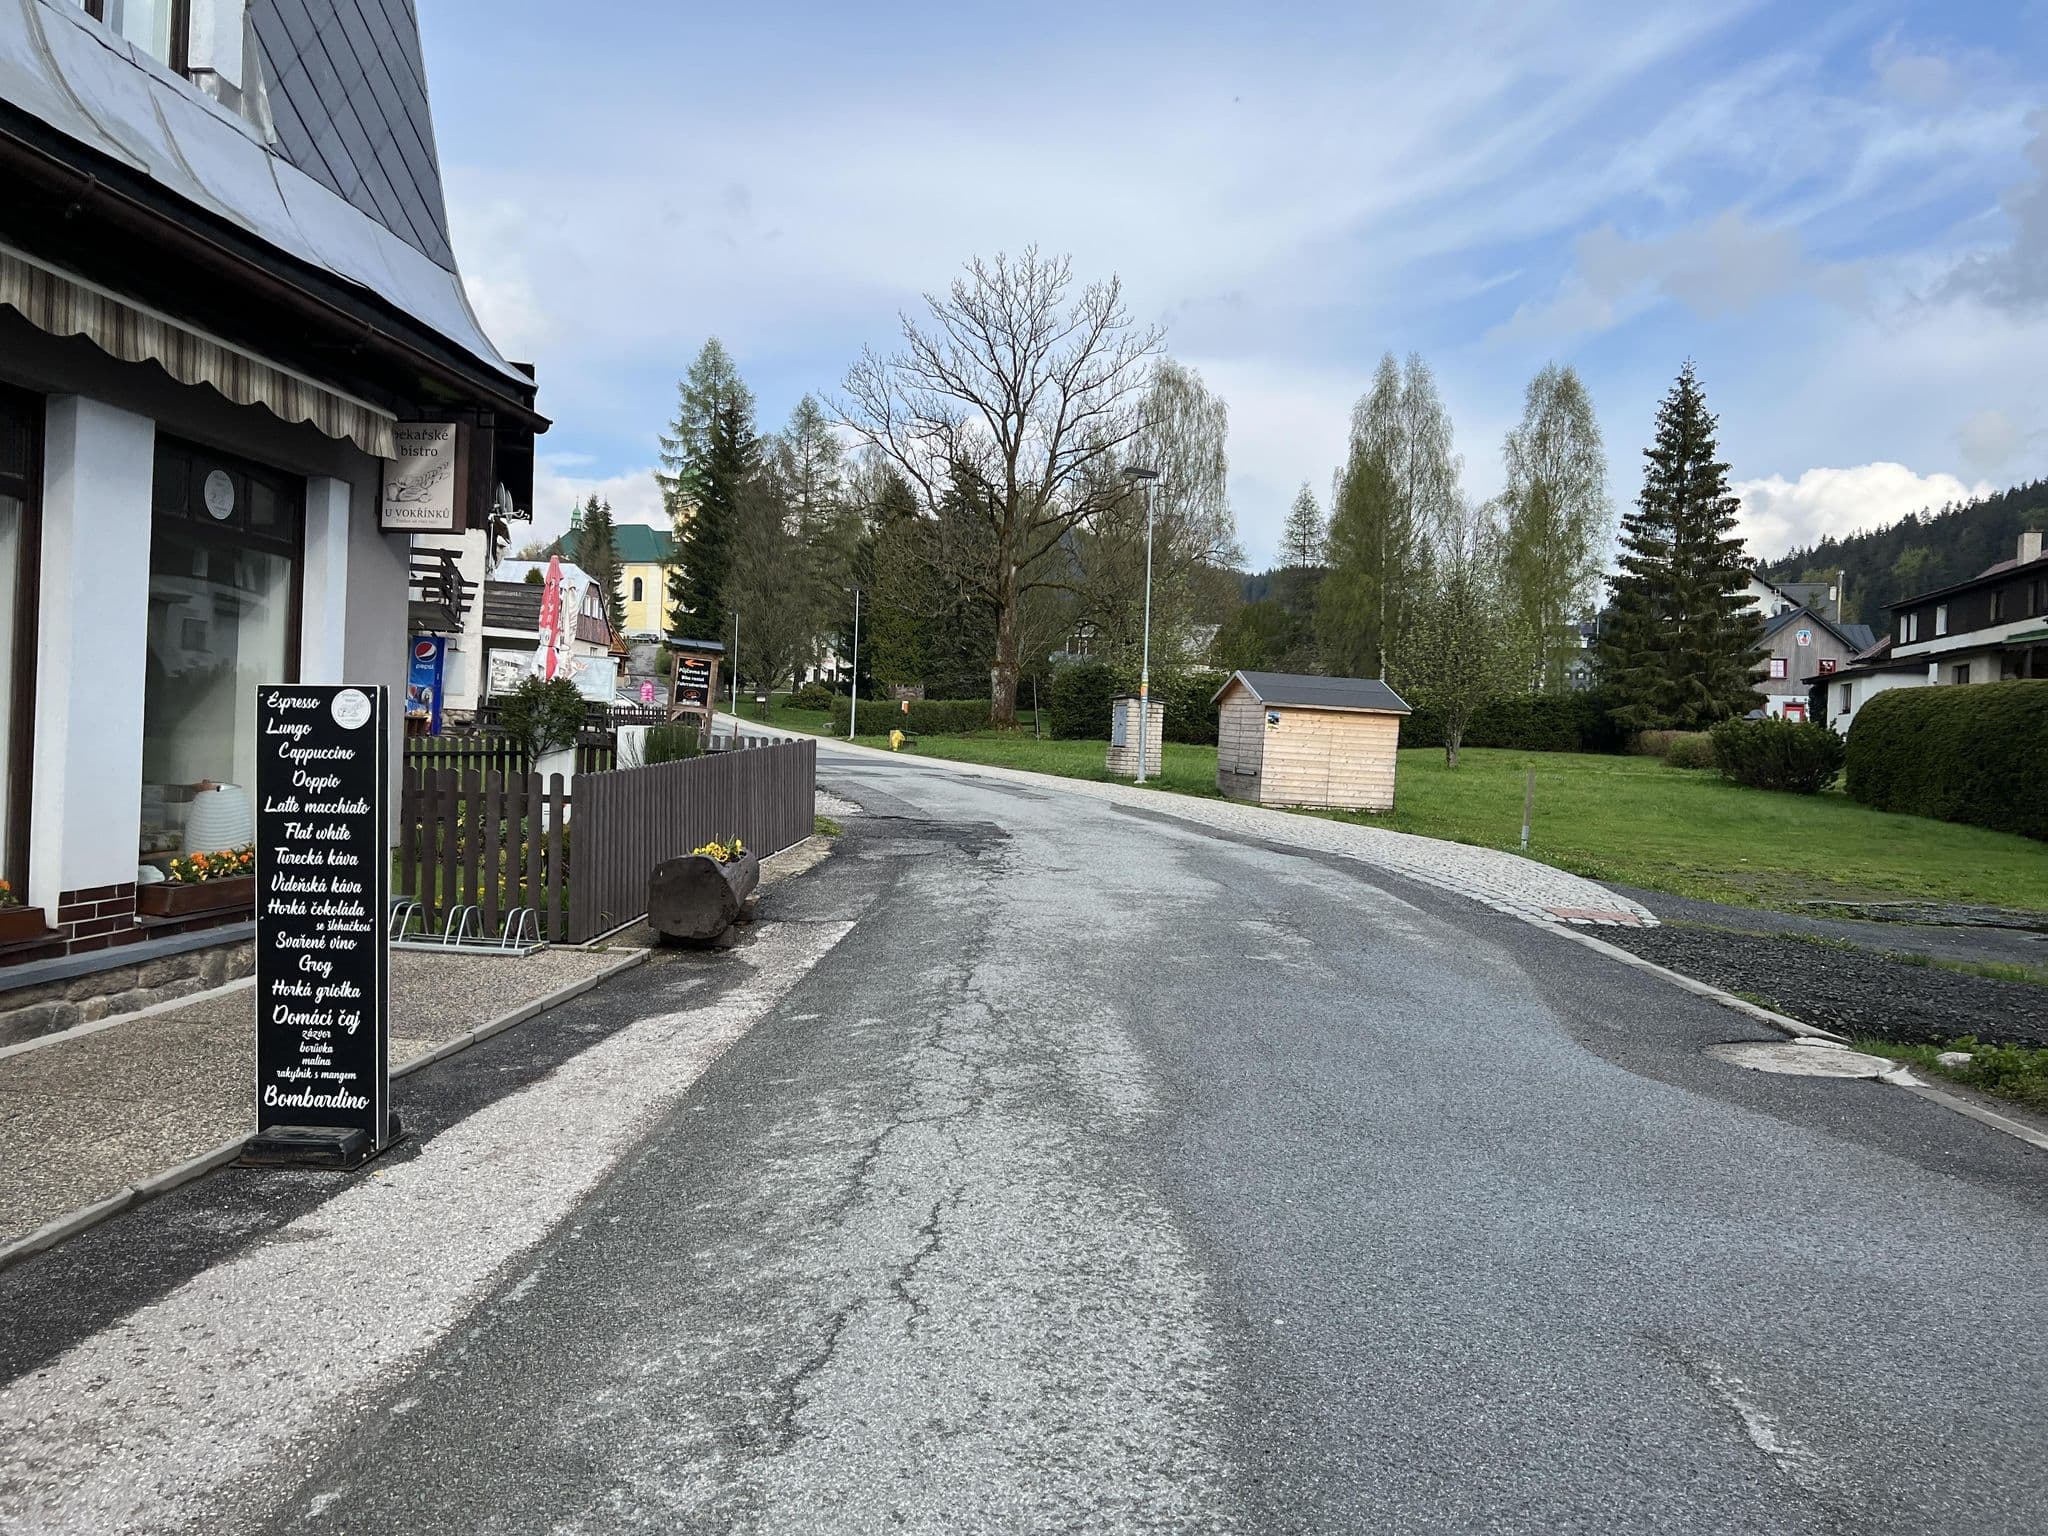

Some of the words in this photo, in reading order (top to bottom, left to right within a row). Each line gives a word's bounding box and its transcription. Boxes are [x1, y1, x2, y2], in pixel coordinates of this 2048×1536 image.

[400, 445, 438, 456] bistro
[385, 508, 392, 517] U
[396, 507, 449, 518] VOKŘÍNKŮ
[267, 691, 320, 715] Espresso
[266, 717, 312, 741] Lungo
[278, 741, 356, 766] Cappuccino
[292, 770, 341, 794] Doppio
[264, 795, 300, 813] Latte
[304, 797, 371, 814] macchiato
[283, 822, 314, 839] Flat
[315, 823, 351, 840] white
[274, 847, 324, 865] Turecká
[327, 848, 359, 866] káva
[271, 871, 327, 893] Vídeňská
[330, 876, 362, 893] káva
[267, 898, 307, 915] Horká
[310, 899, 365, 916] čokoláda
[315, 922, 325, 931] se
[327, 918, 371, 931] šlehačkou
[275, 931, 326, 949] Svařené
[329, 936, 357, 950] víno
[298, 954, 333, 979] Grog
[272, 979, 312, 996] Horká
[314, 981, 361, 1004] griotka
[272, 1004, 333, 1026] Domácí
[337, 1009, 360, 1035] čaj
[301, 1027, 331, 1040] zázvor
[299, 1041, 334, 1053] borůvka
[301, 1054, 331, 1066] malina
[314, 1071, 319, 1079] s
[320, 1071, 357, 1084] mangem
[263, 1084, 370, 1110] Bombardino
